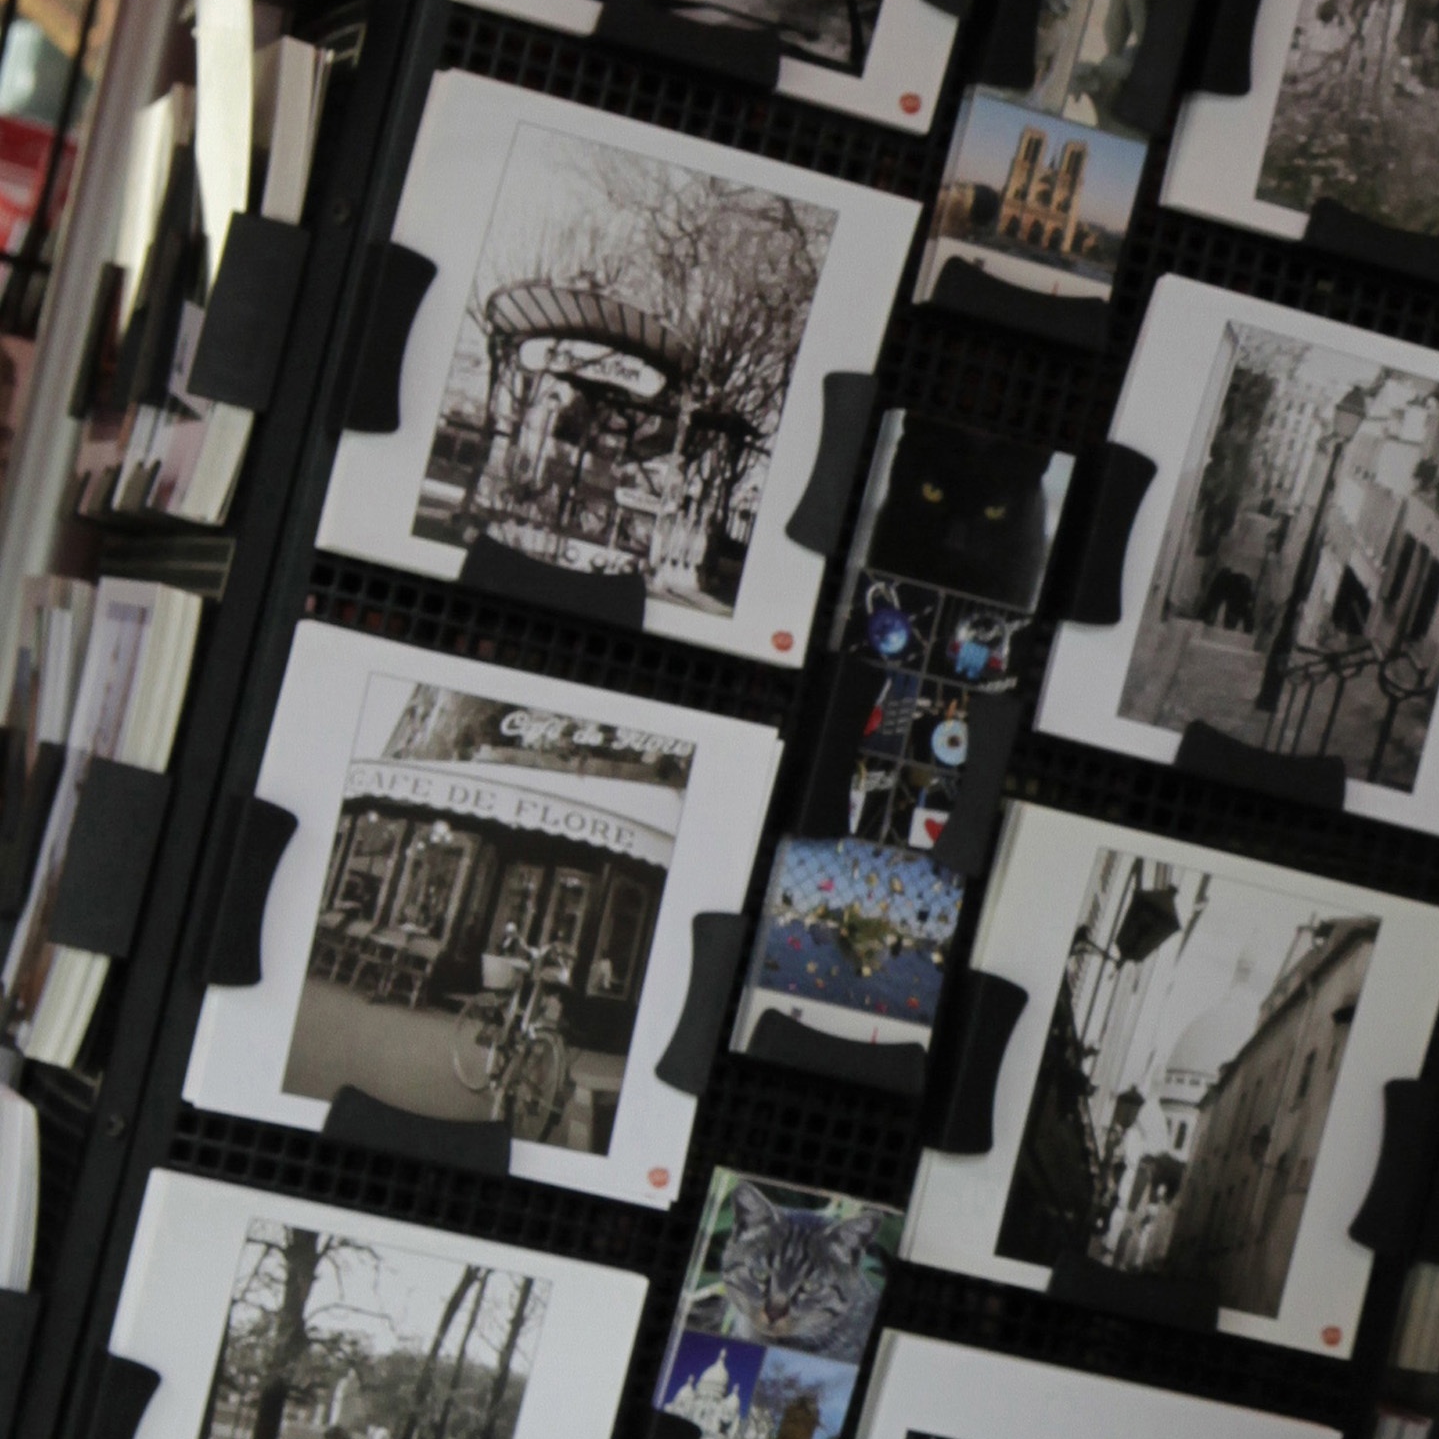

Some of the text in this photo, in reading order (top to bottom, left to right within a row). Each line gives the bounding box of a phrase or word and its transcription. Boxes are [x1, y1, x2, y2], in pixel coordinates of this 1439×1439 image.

[573, 721, 605, 746] de
[347, 765, 636, 850] CAFE DE FLORE
